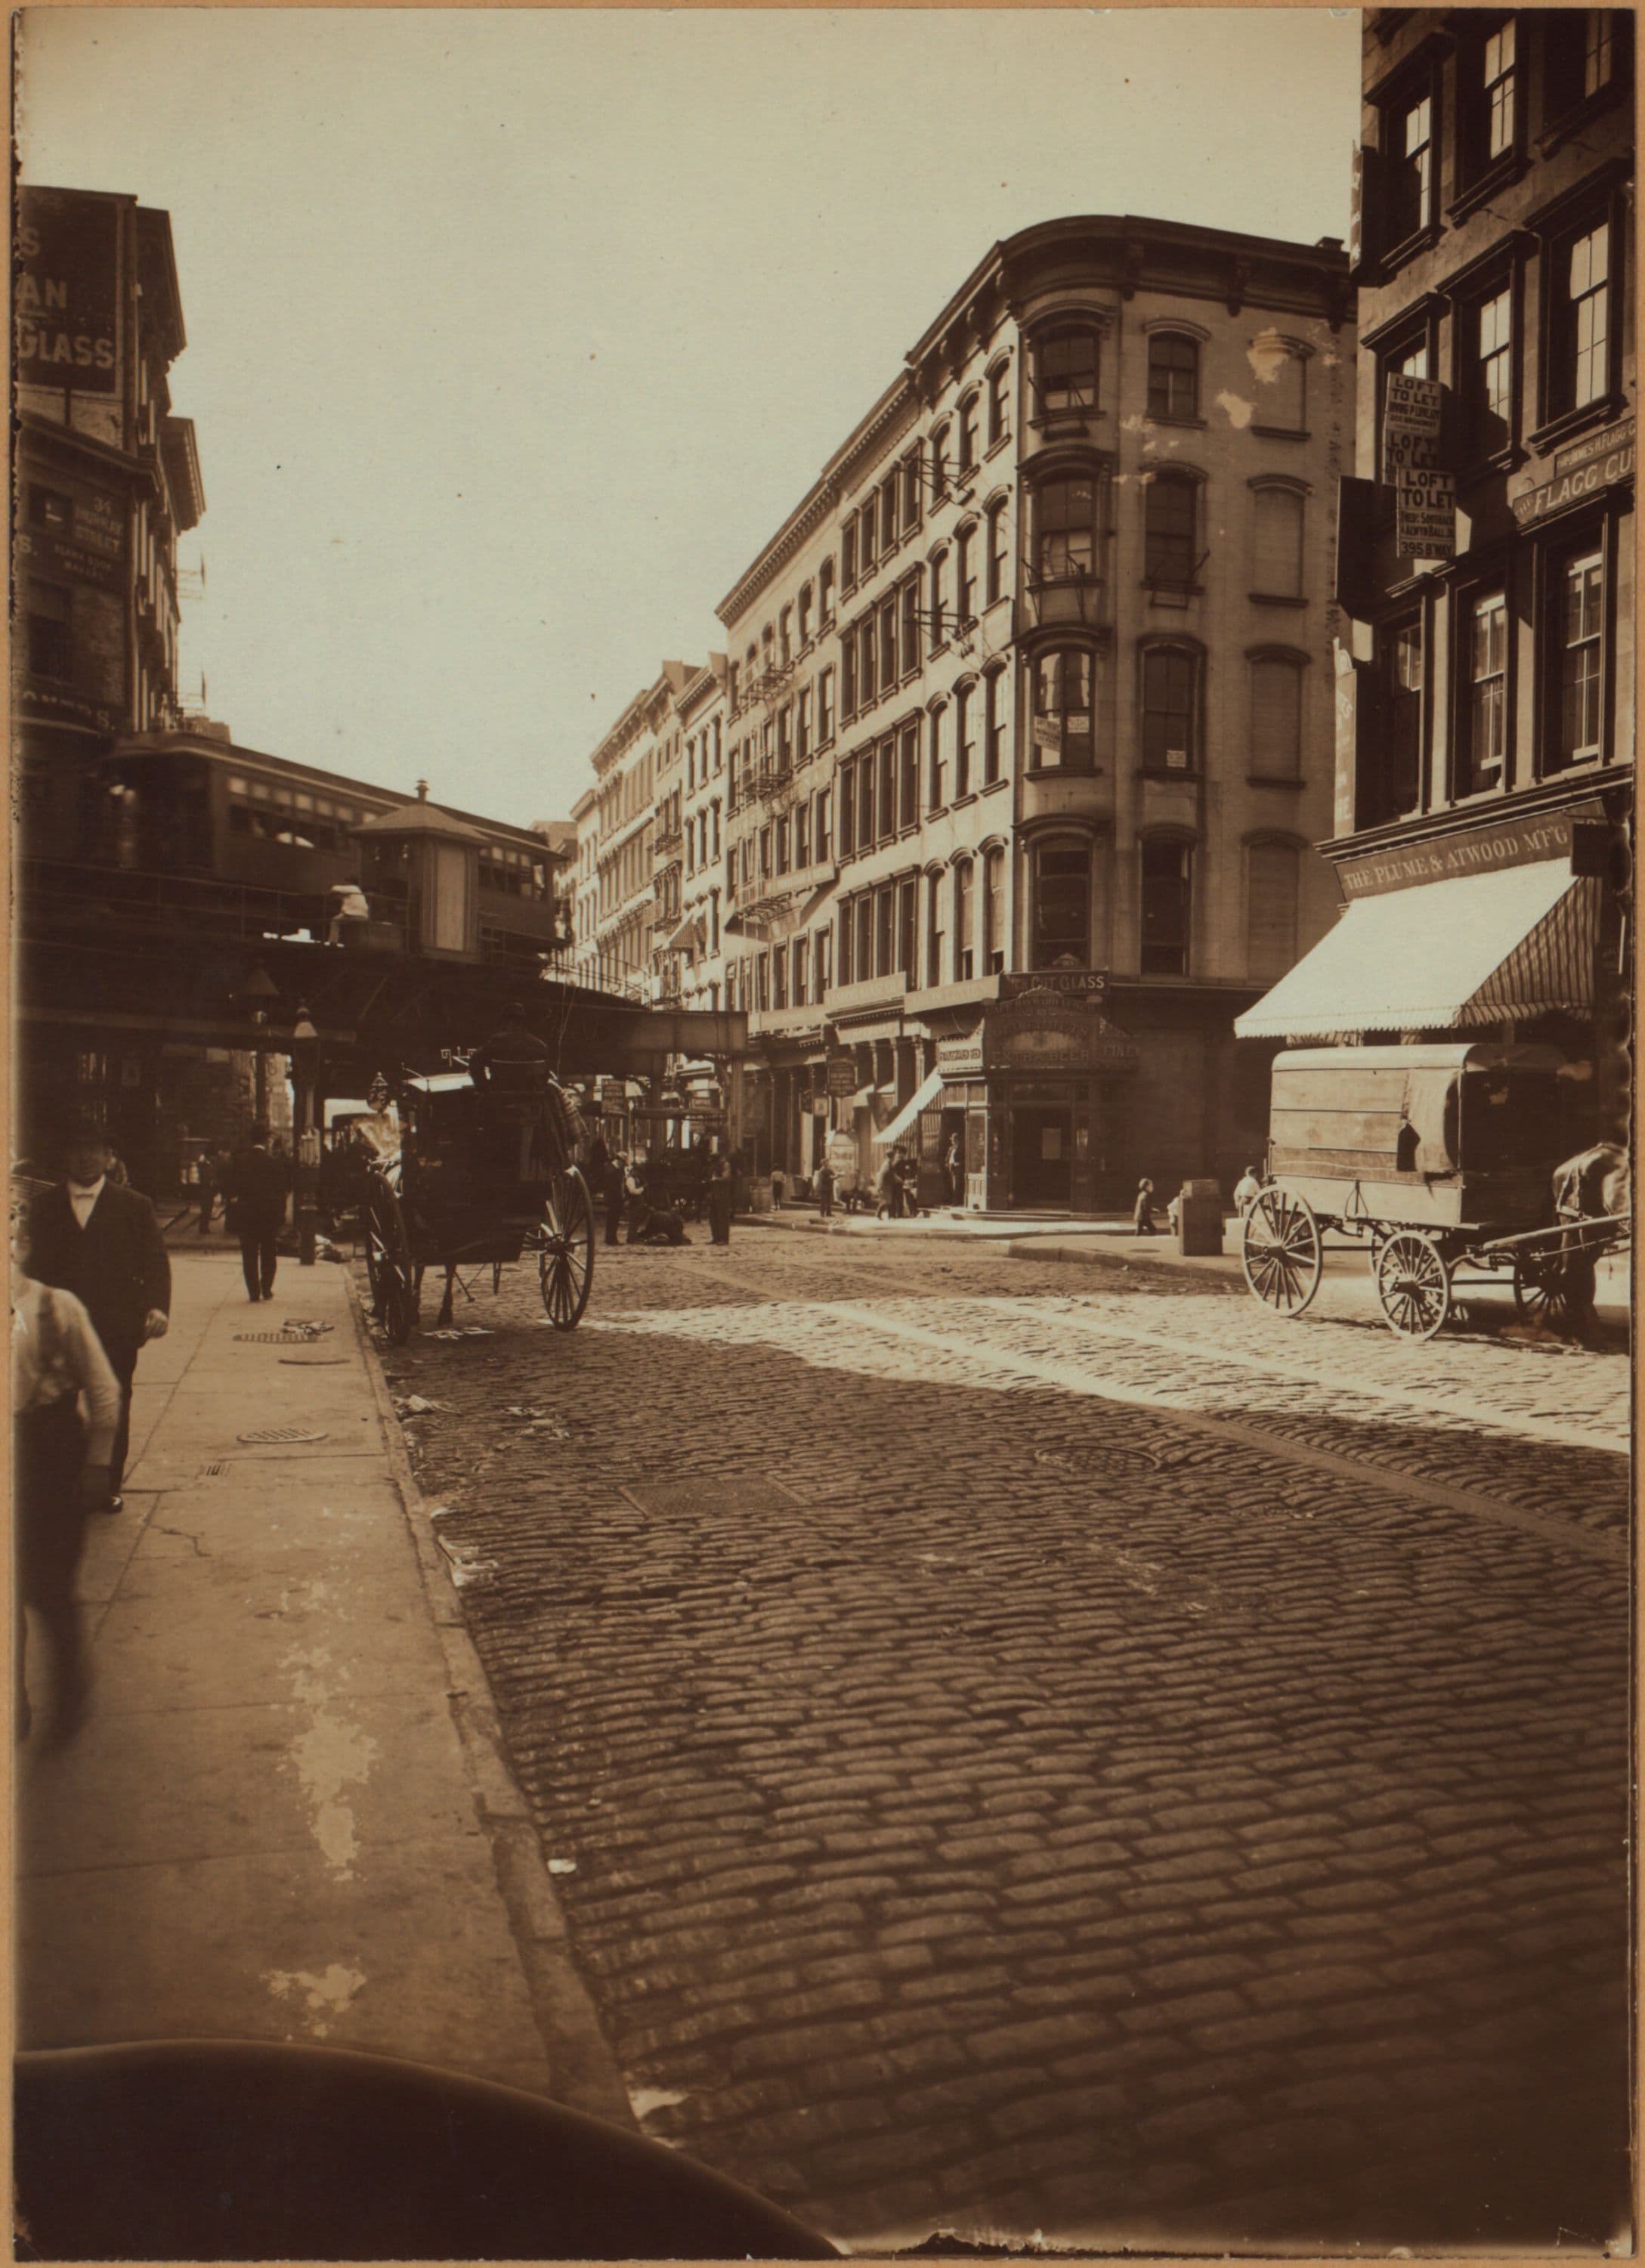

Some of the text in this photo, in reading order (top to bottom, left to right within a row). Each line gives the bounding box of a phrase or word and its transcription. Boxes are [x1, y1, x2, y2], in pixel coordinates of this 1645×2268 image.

[19, 317, 116, 370] GLASS
[1395, 377, 1436, 394] LOFT
[1391, 388, 1439, 407] TO LET
[1390, 432, 1434, 453] LOFT
[1386, 447, 1404, 464] TO
[1405, 471, 1451, 490] LOFT
[1534, 464, 1597, 515] FLAGG
[1401, 488, 1455, 509] TO LET
[1401, 540, 1424, 555] 395
[1344, 869, 1374, 890] THE
[1375, 856, 1429, 884] PLUME
[1428, 853, 1444, 873] &
[1446, 837, 1520, 869] ATWOOD
[1059, 974, 1105, 990] GLASS
[1049, 1048, 1089, 1062] BEER
